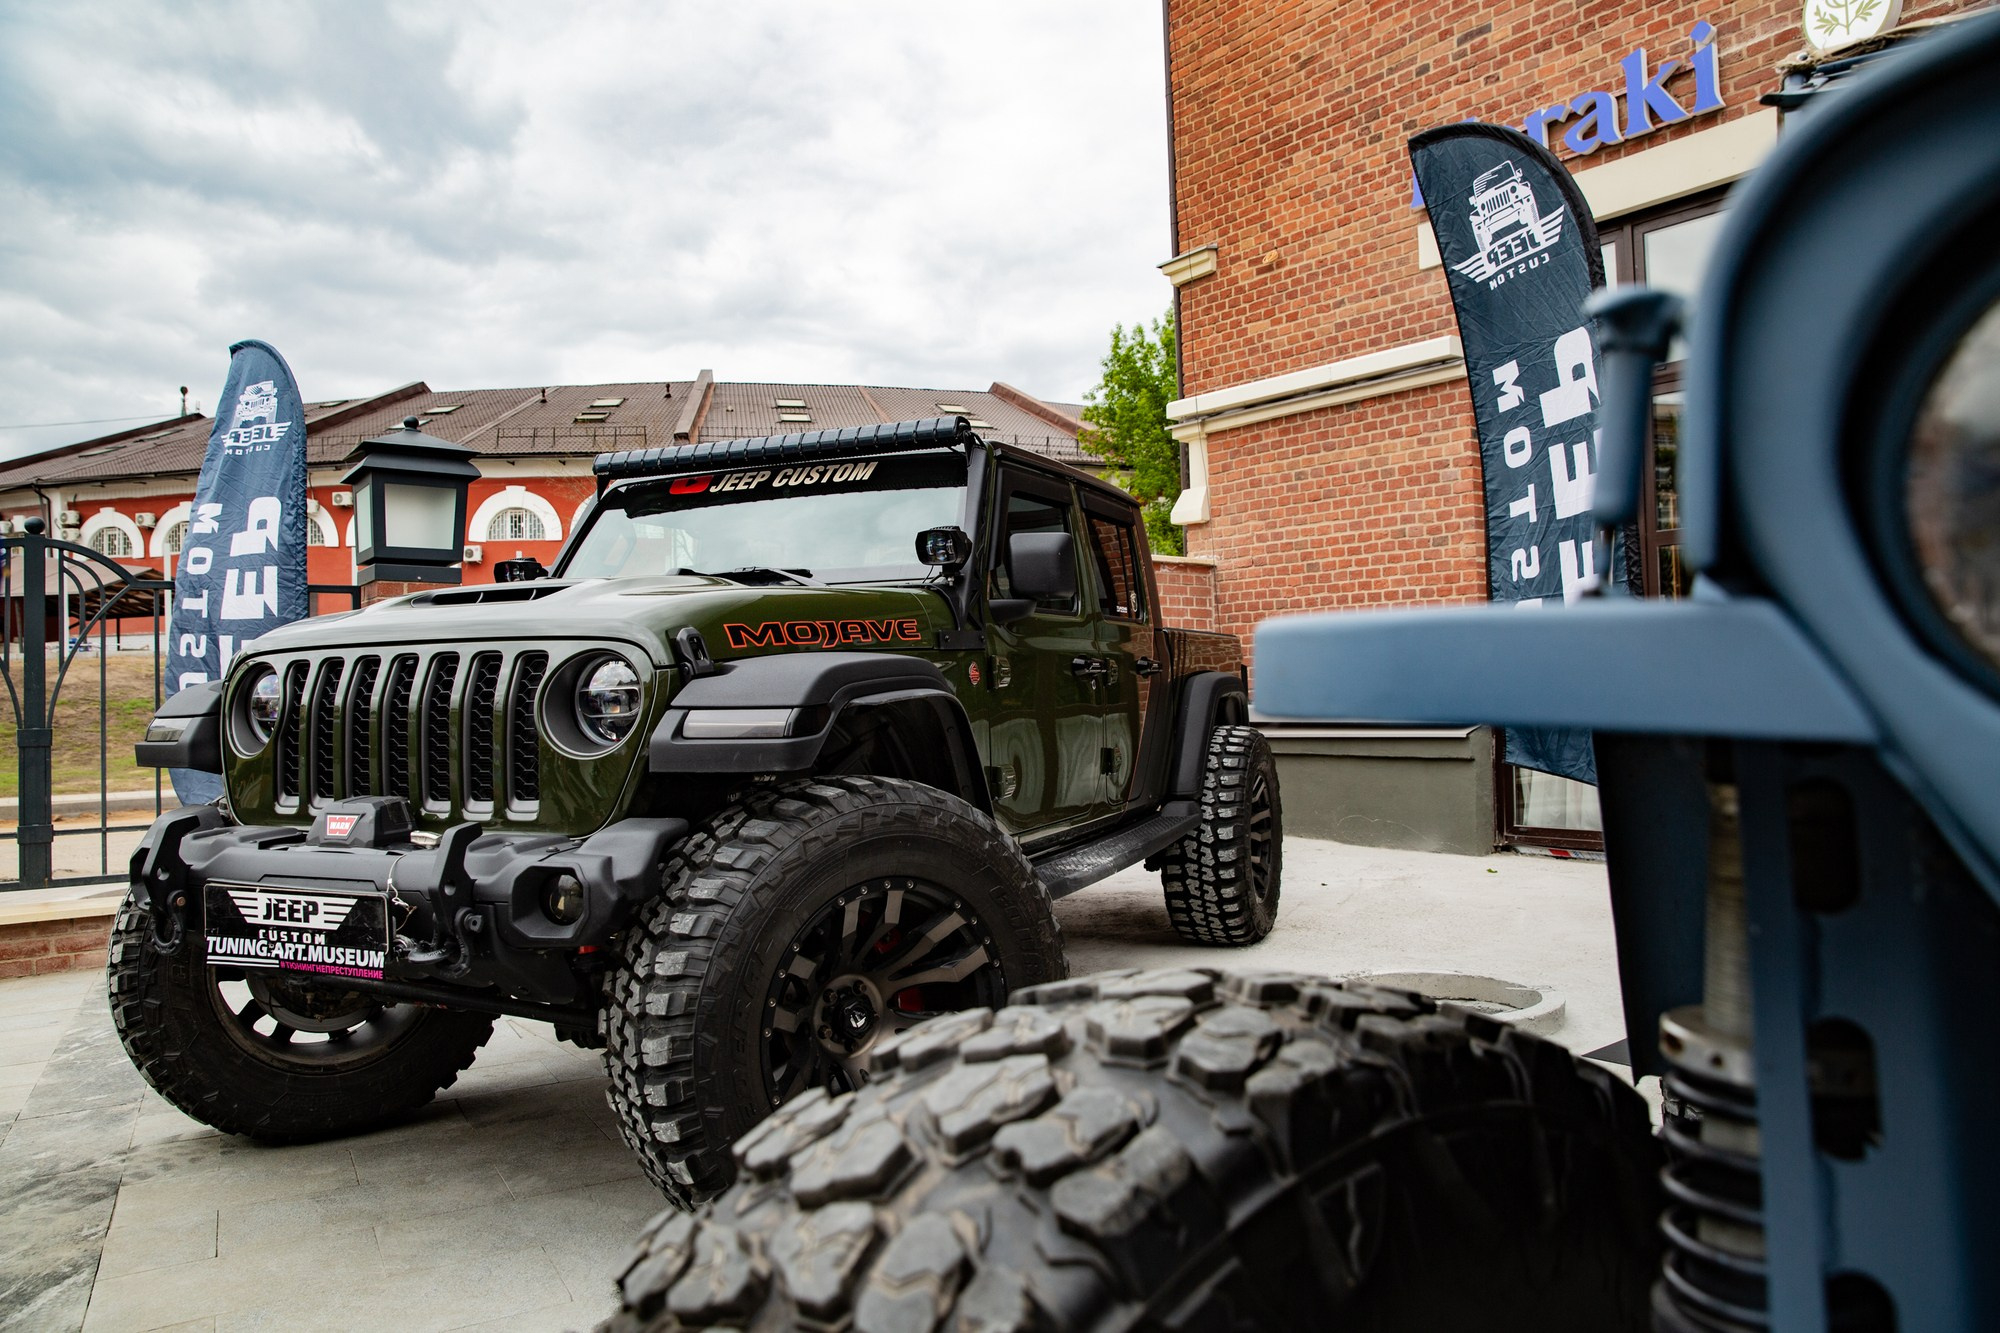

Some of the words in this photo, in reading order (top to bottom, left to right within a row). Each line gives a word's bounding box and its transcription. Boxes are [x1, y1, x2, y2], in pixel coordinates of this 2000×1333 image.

[709, 470, 771, 493] JEEP
[772, 461, 878, 487] CUSTOM
[723, 618, 921, 648] MOJAVE
[329, 821, 351, 830] WARN
[263, 897, 319, 923] JEEP
[258, 929, 326, 945] CUSTOM
[206, 936, 386, 968] TUNING.ART.MUSEUM
[279, 961, 384, 979] #ТЮНИНГНЕПРЕСТУПЛЕНИЕ
